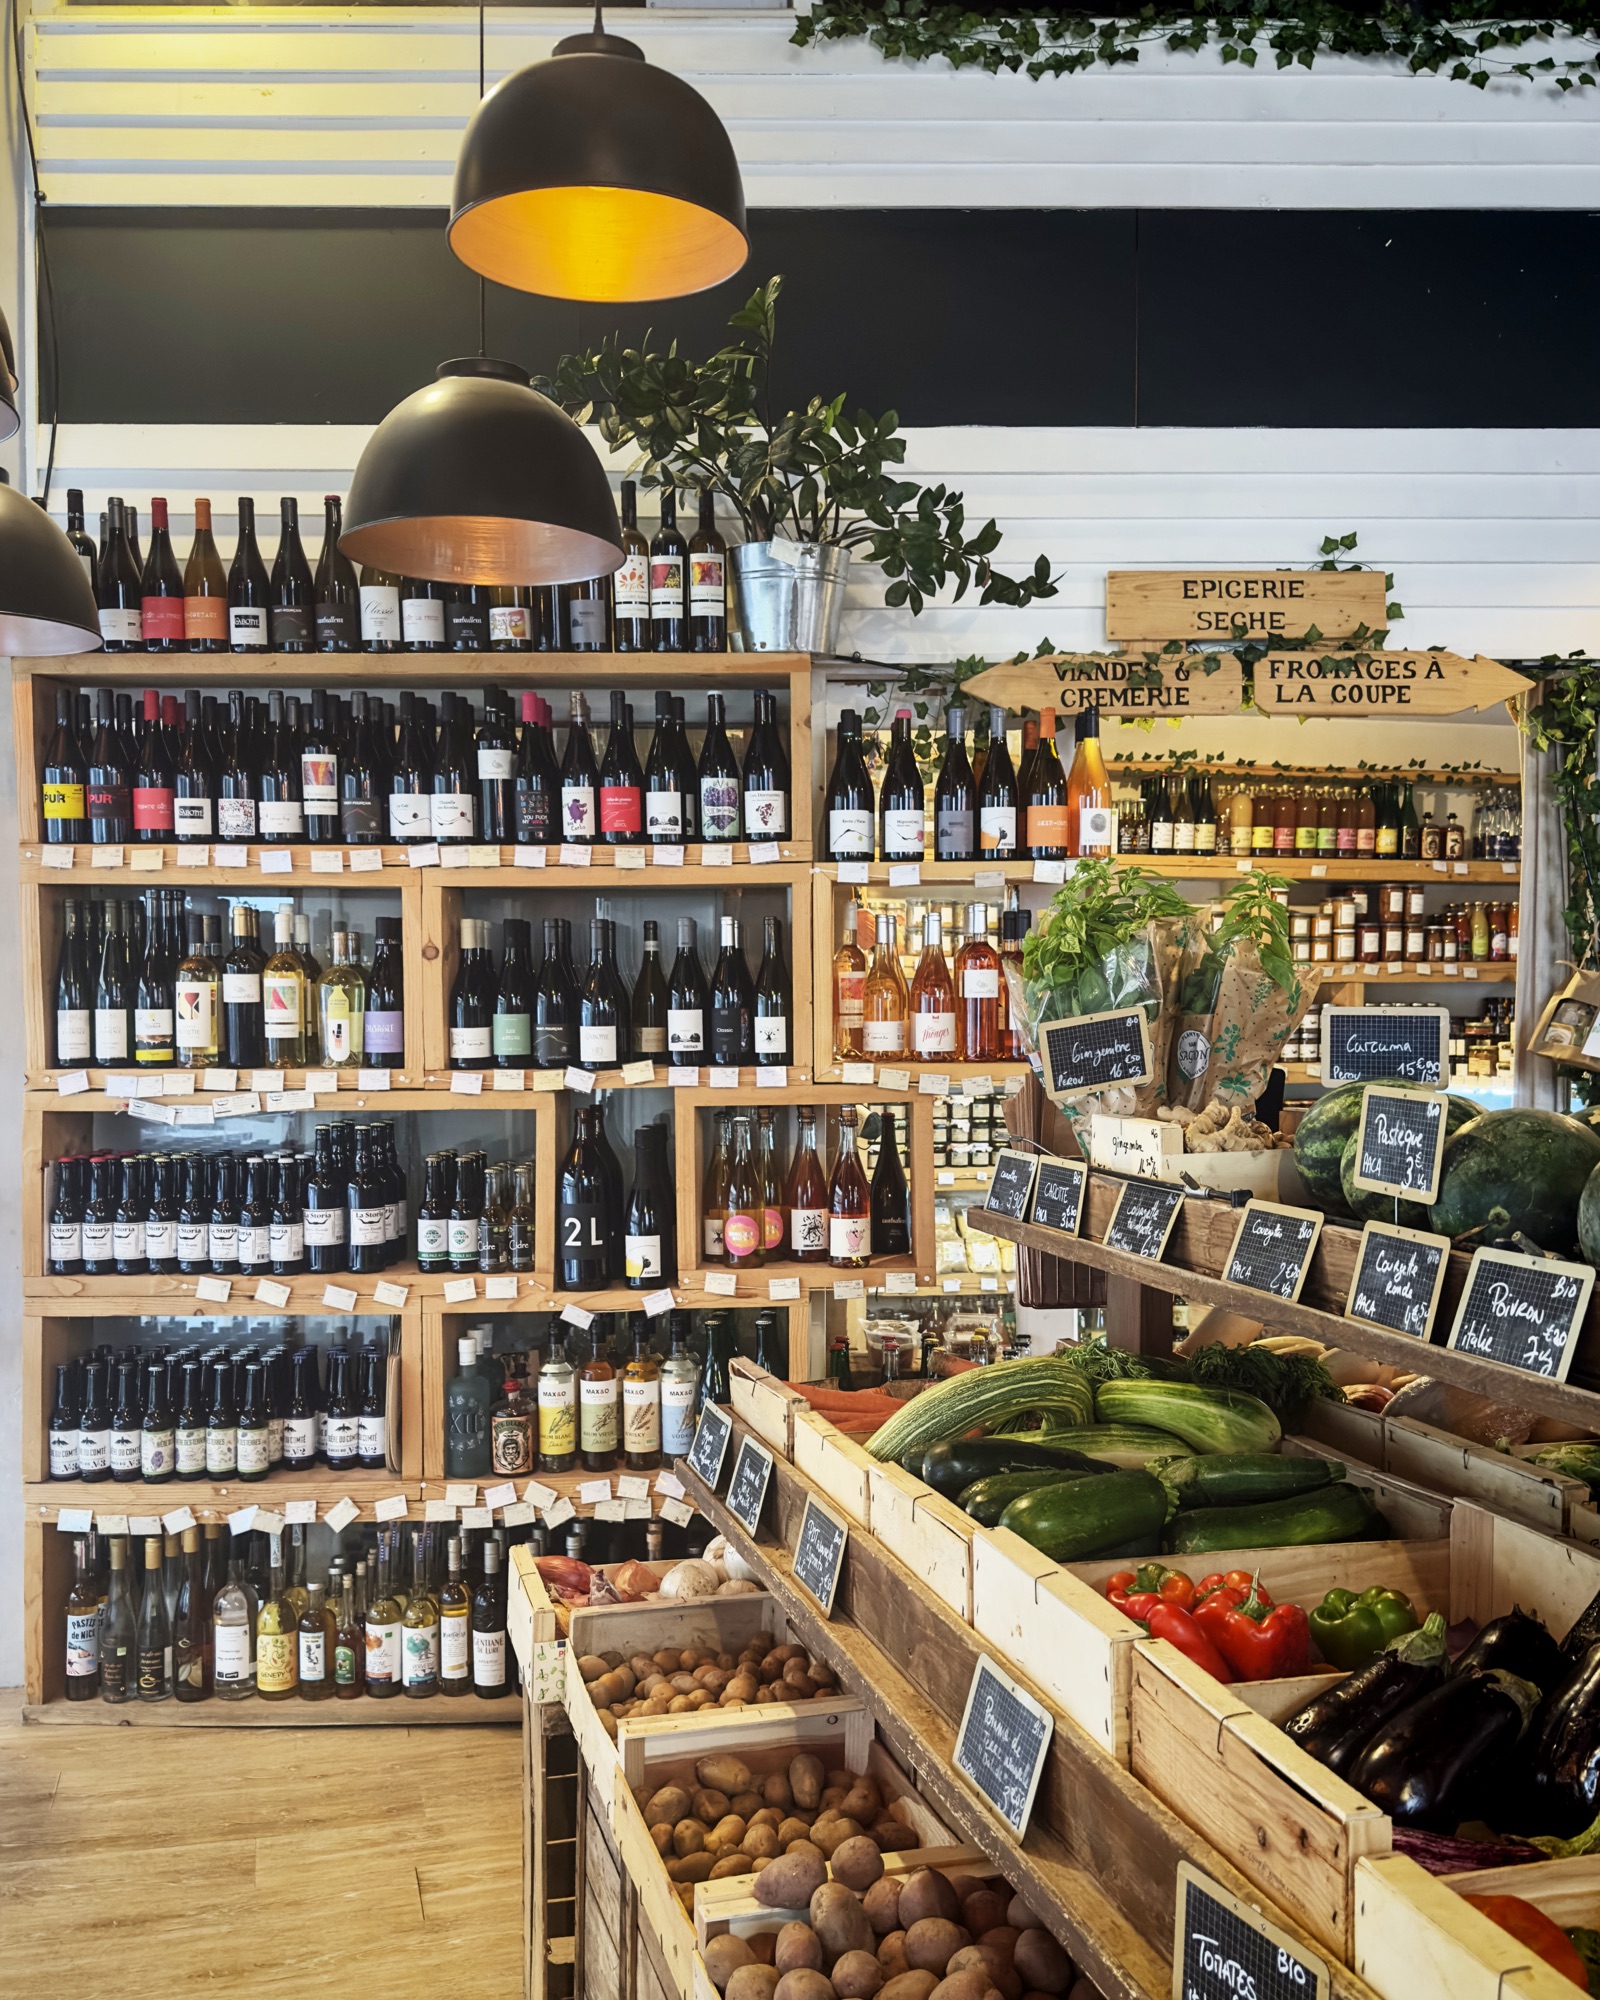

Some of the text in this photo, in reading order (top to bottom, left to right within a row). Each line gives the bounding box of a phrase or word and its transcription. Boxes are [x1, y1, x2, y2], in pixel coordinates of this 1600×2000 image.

[1182, 579, 1305, 600] EPICERIE
[1174, 660, 1190, 682] &
[1423, 655, 1446, 680] À
[1060, 687, 1190, 708] CREMERIE
[1275, 684, 1411, 704] LA COUPE
[1346, 1033, 1412, 1054] Curcuma
[56, 1225, 79, 1233] Storia
[89, 1225, 111, 1233] Storia
[216, 1226, 238, 1234] Storia
[508, 1239, 530, 1251] Cidre
[1550, 1276, 1578, 1300] Bio
[1277, 1947, 1307, 1985] BIO
